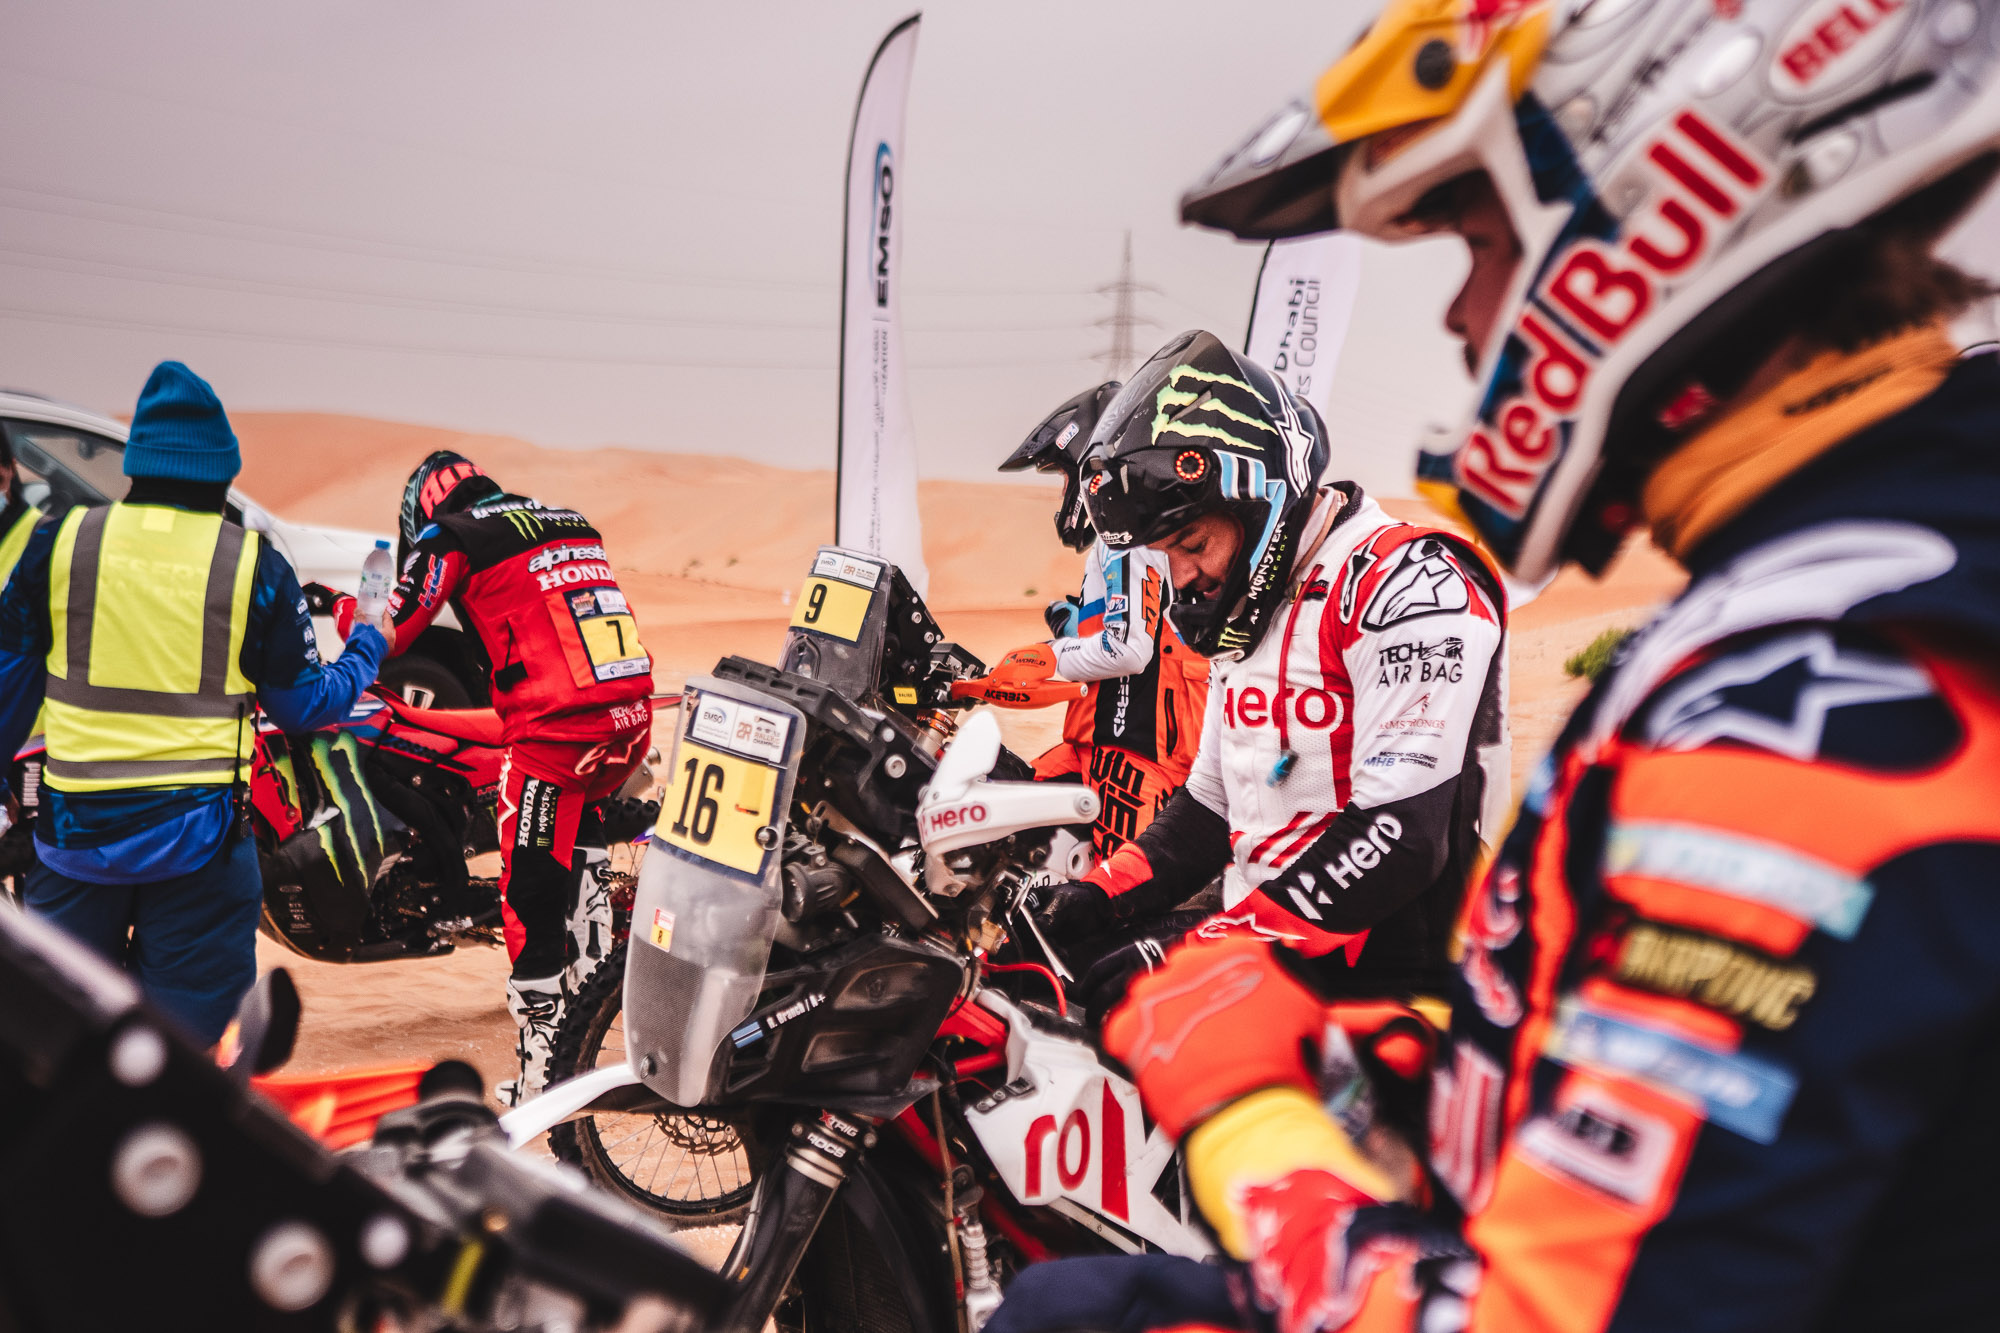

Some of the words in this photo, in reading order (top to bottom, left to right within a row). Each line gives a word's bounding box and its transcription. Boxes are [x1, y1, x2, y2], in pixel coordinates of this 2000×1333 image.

[876, 164, 894, 308] EMSO
[1274, 278, 1308, 372] Dhabi
[1294, 279, 1321, 368] Council
[1460, 313, 1592, 515] Red
[1548, 109, 1767, 343] Bull
[1247, 520, 1286, 600] MONSTER
[605, 619, 627, 657] 7
[803, 583, 828, 624] 9
[1376, 664, 1412, 689] AIR
[1420, 662, 1463, 684] BAG
[615, 716, 631, 732] AIR
[631, 709, 648, 726] BAG
[518, 779, 540, 848] HONDA
[671, 757, 725, 847] 16
[930, 804, 987, 833] Hero
[1324, 813, 1403, 890] Hero
[818, 1108, 860, 1137] XTRIG
